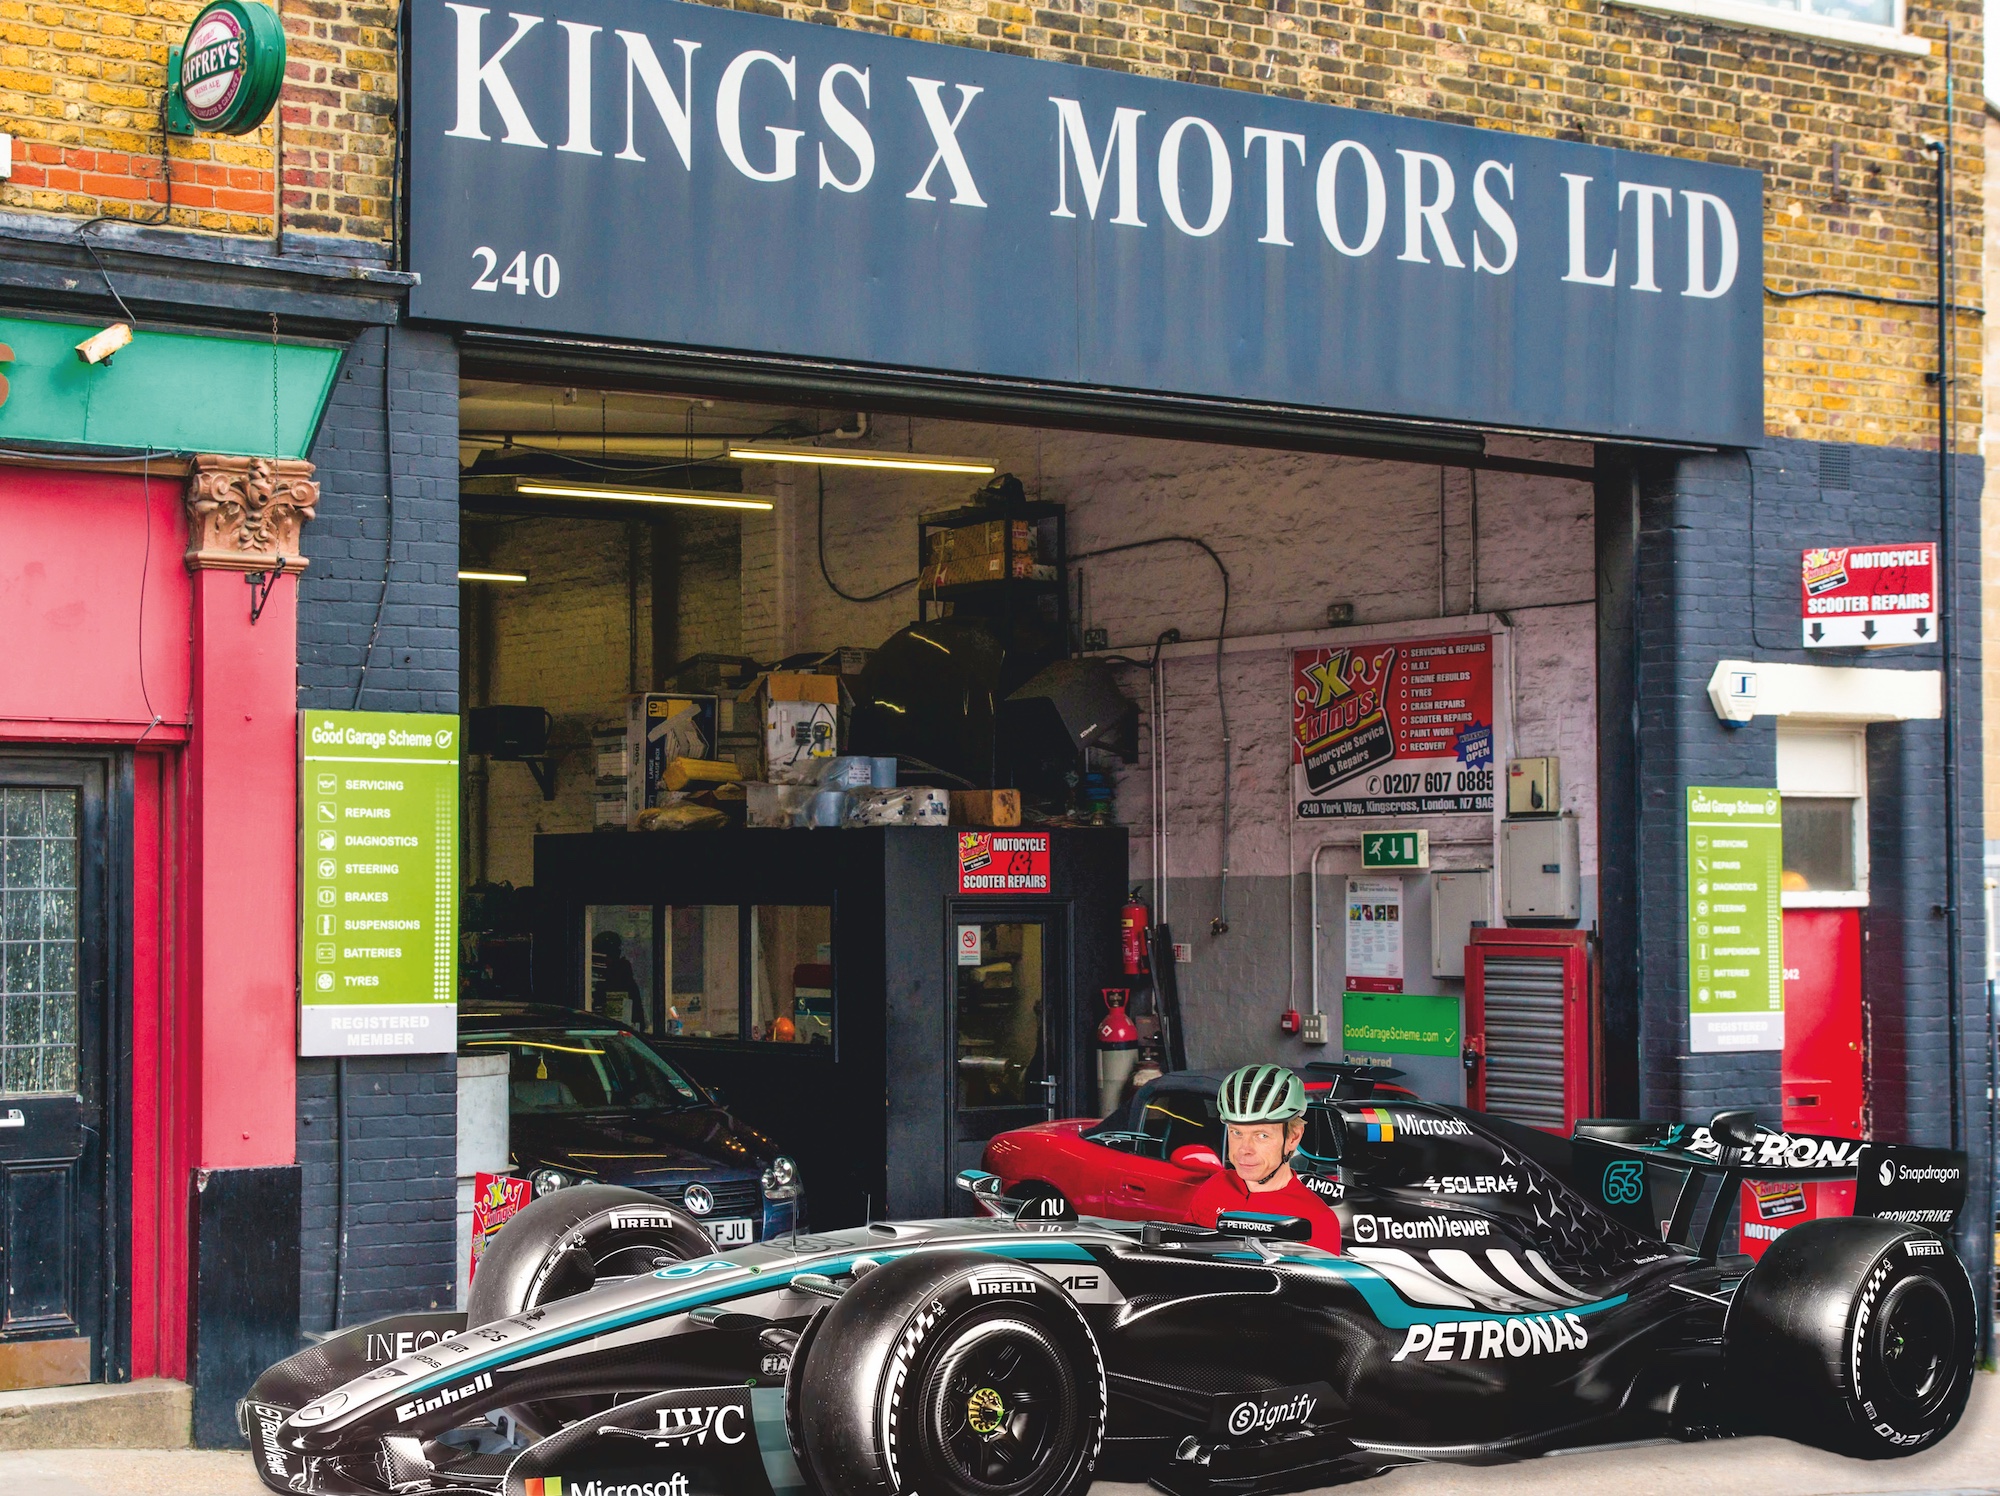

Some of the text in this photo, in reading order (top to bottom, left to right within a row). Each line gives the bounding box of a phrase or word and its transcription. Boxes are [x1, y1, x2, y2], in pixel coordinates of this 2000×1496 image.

[182, 40, 240, 87] CAFFREY'S
[208, 79, 221, 89] ALE
[444, 2, 1740, 299] KINGS X MOTORS LTD
[471, 246, 560, 299] 240
[1850, 550, 1930, 569] MOTOCYCLE
[1807, 593, 1930, 614] SCOOTER REPAIRS
[1410, 643, 1486, 657] SERVICING & REPAIRS
[1411, 662, 1430, 670] M.O.T
[1310, 655, 1351, 708] X
[1410, 672, 1470, 684] ENGINE REBUILDS
[1410, 688, 1432, 697] TYRES
[1410, 700, 1466, 711] CRASH REPAIRS
[1305, 689, 1374, 745] kings
[1410, 712, 1472, 724] SCOOTER REPAIRS
[324, 720, 334, 730] the
[312, 726, 432, 749] Good Garage Scheme
[1410, 728, 1454, 738] PAINT WORK
[1308, 725, 1385, 770] Motorcycle Service
[1410, 742, 1447, 751] RECOVERY
[1466, 738, 1488, 753] NOW
[1466, 747, 1490, 762] OPEN
[1329, 750, 1370, 776] & Repairs
[345, 780, 404, 791] SERVICING
[1384, 770, 1494, 794] 0207 607 0885
[345, 808, 391, 818] REPAIRS
[1302, 802, 1319, 814] 240
[1322, 802, 1342, 814] York
[1343, 802, 1364, 814] Way,
[1366, 800, 1420, 814] Kingscross,
[1422, 798, 1458, 811] London.
[1460, 798, 1472, 809] N7
[1692, 800, 1764, 816] Good Garage Scheme
[345, 836, 418, 846] DIAGNOSTICS
[993, 838, 1046, 852] MOTOCYCLE
[1712, 840, 1748, 848] SERVICING
[345, 864, 399, 874] STEERING
[1008, 851, 1032, 876] &
[1712, 861, 1741, 870] REPAIRS
[963, 874, 1047, 888] SCOOTER REPAIRS
[1712, 883, 1758, 892] DIAGNOSTICS
[344, 892, 389, 902] BRAKES
[1713, 904, 1747, 913] STEERING
[344, 920, 420, 930] SUSPENSIONS
[1713, 926, 1740, 934] BRAKES
[344, 948, 402, 958] BATTERIES
[1714, 947, 1760, 956] SUSPENSIONS
[1714, 968, 1750, 978] BATTERIES
[1782, 968, 1800, 980] 242
[344, 976, 379, 986] TYRES
[1714, 990, 1737, 999] TYRES
[331, 1016, 430, 1030] REGISTERED
[1708, 1021, 1768, 1032] REGISTERED
[347, 1033, 414, 1046] MEMBER
[1344, 1024, 1439, 1042] GoodGarageScheme.com
[1718, 1034, 1759, 1045] MEMBER
[1396, 1114, 1474, 1136] Microsoft
[1899, 1165, 1960, 1183] Snapdragon
[1306, 1178, 1334, 1194] AMD
[1444, 1176, 1508, 1194] SOLERA
[1602, 1160, 1644, 1204] 63
[490, 1180, 506, 1208] X
[608, 1212, 673, 1229] PIRELLI
[1227, 1221, 1275, 1232] PETRONAS
[1377, 1215, 1491, 1240] TeamViewer
[715, 1222, 746, 1242] FJU
[1904, 1240, 1944, 1256] PIRELLI
[968, 1276, 1037, 1296] PIRELLI
[1391, 1312, 1589, 1362] PETRONAS
[395, 1372, 494, 1424] Einhell
[654, 1405, 746, 1448] IWC
[1874, 1422, 1935, 1446] ZERO
